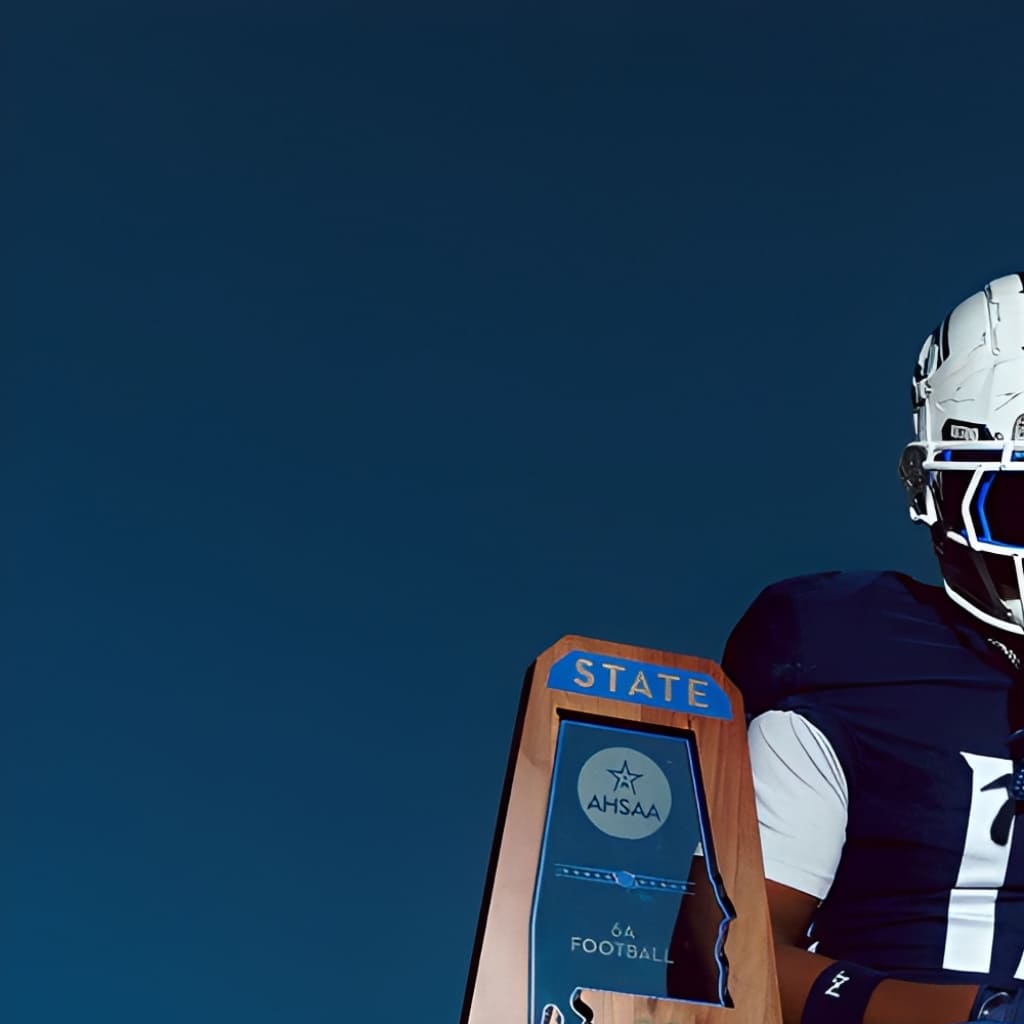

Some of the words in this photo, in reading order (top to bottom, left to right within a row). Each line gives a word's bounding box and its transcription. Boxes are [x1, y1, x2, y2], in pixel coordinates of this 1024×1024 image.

[573, 658, 709, 708] STATE
[587, 795, 662, 821] AHSAA
[571, 936, 675, 965] FOOTBALL
